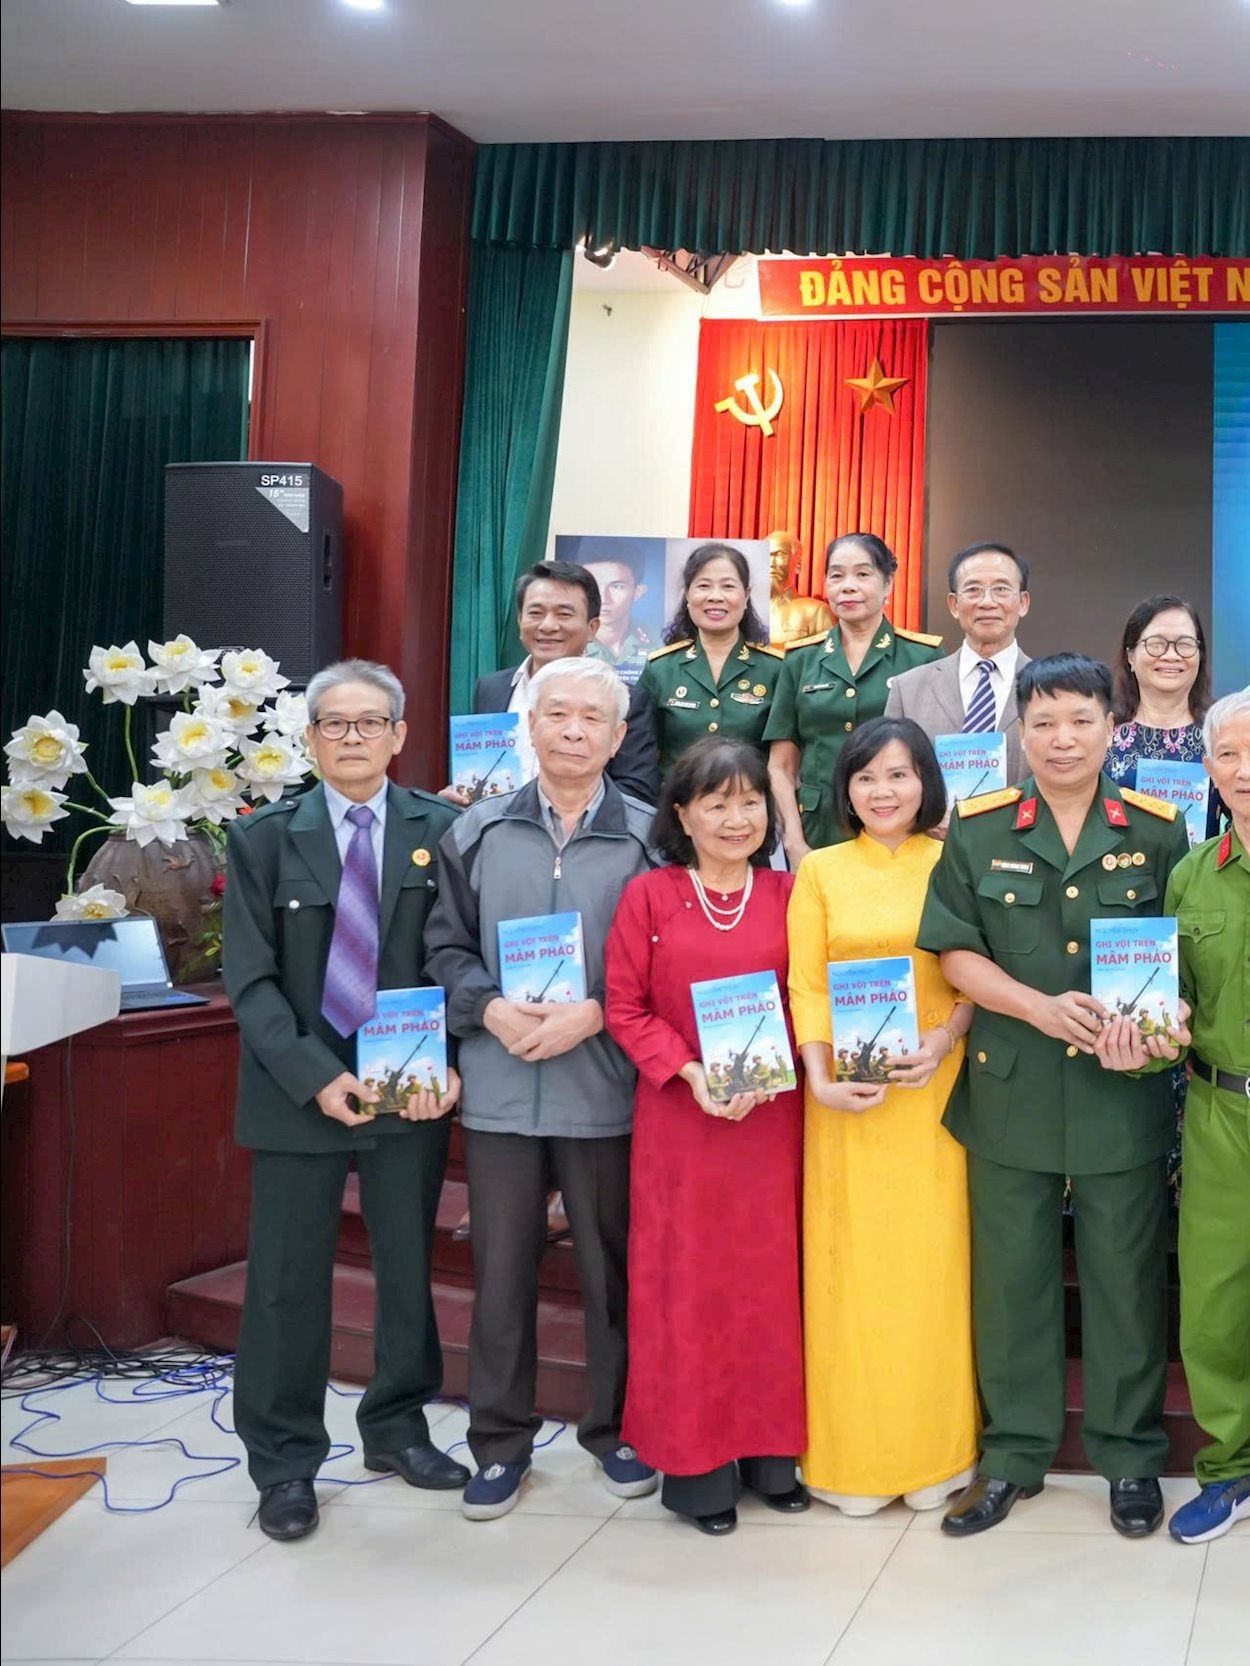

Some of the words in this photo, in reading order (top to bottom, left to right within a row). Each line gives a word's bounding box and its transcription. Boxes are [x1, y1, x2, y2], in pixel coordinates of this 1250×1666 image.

[799, 259, 906, 306] ĐẢNG
[918, 261, 1025, 311] CỘNG
[1039, 257, 1118, 303] SẢN
[1131, 259, 1213, 309] VIỆT
[261, 474, 303, 486] SP415
[1140, 785, 1168, 799] MÂM
[1171, 787, 1204, 801] PHÁO
[1095, 940, 1112, 949] GHI
[1096, 950, 1129, 965] MÂM
[1134, 948, 1172, 964] PHÁO
[835, 991, 866, 1007] MÂM
[870, 988, 908, 1004] PHÁO
[701, 1007, 735, 1023] MÂM
[738, 1000, 776, 1016] PHÁO
